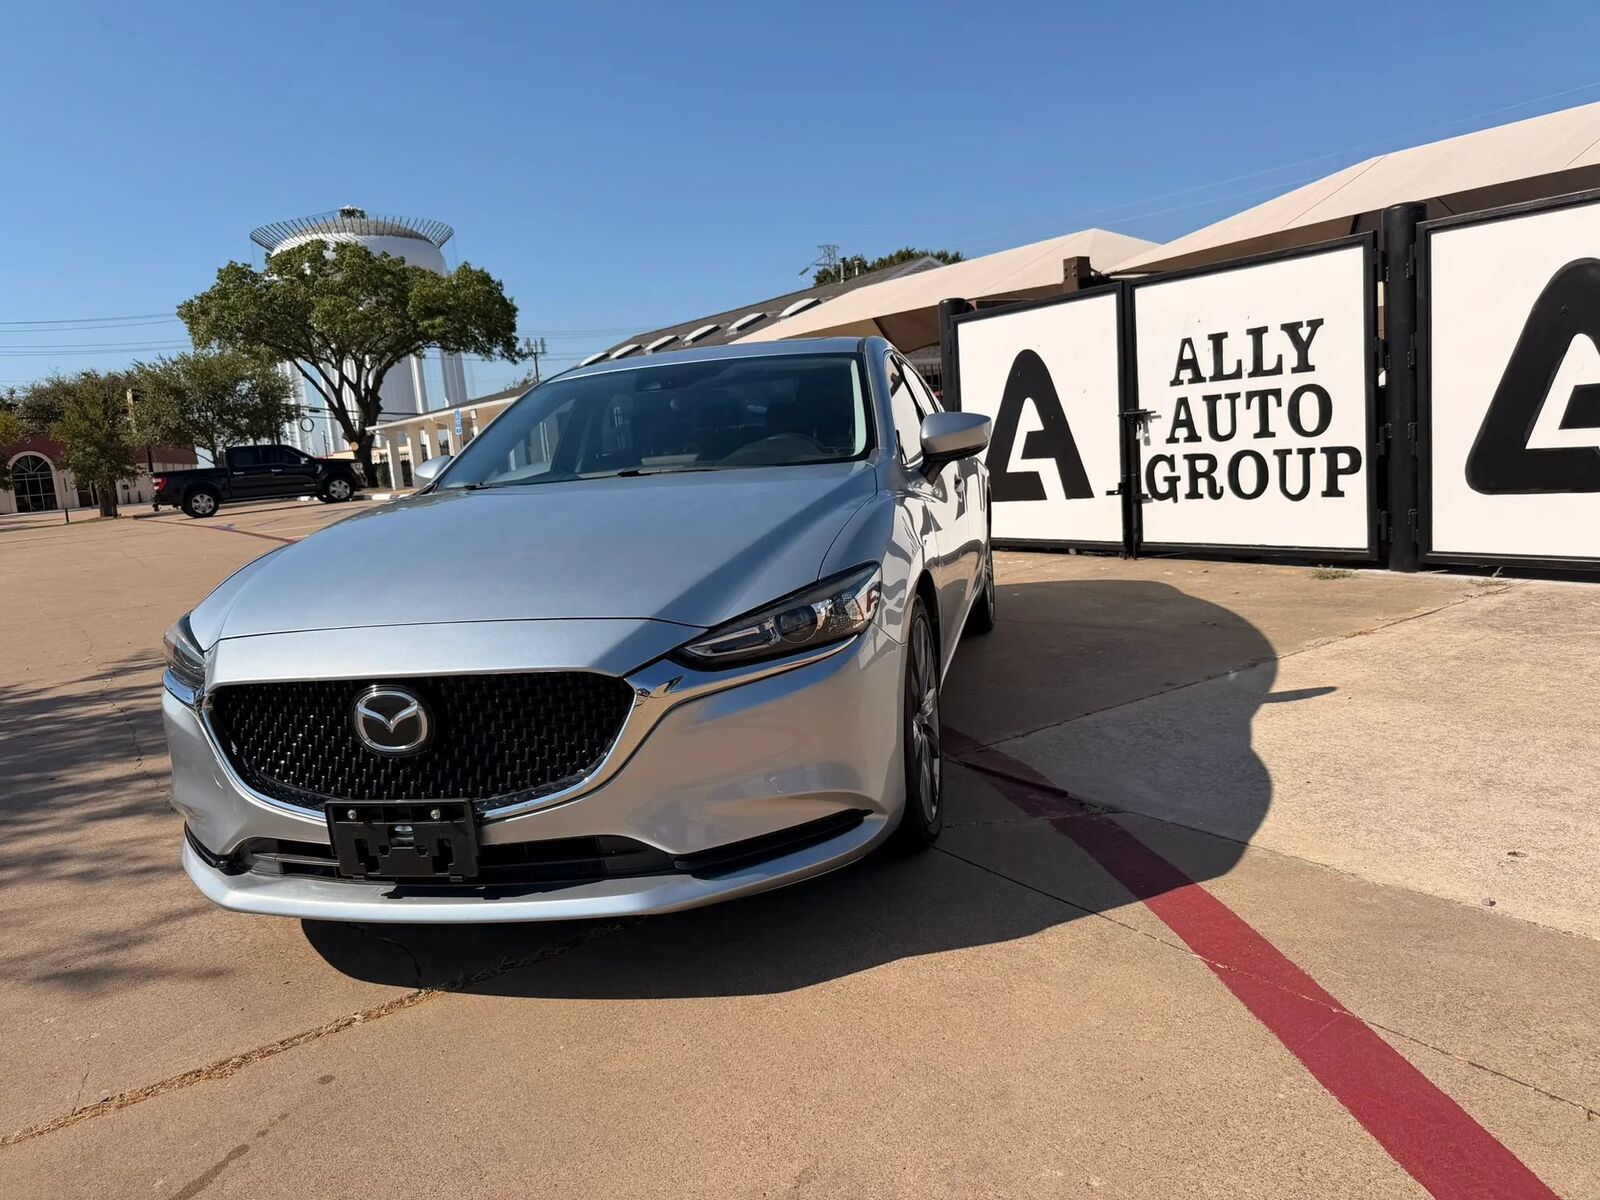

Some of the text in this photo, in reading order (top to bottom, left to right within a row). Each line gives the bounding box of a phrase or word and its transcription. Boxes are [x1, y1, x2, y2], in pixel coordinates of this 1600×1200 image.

[1169, 317, 1324, 387] ALLY
[985, 348, 1095, 503] A
[1165, 383, 1333, 444] AUTO
[1145, 445, 1363, 503] GROUP
